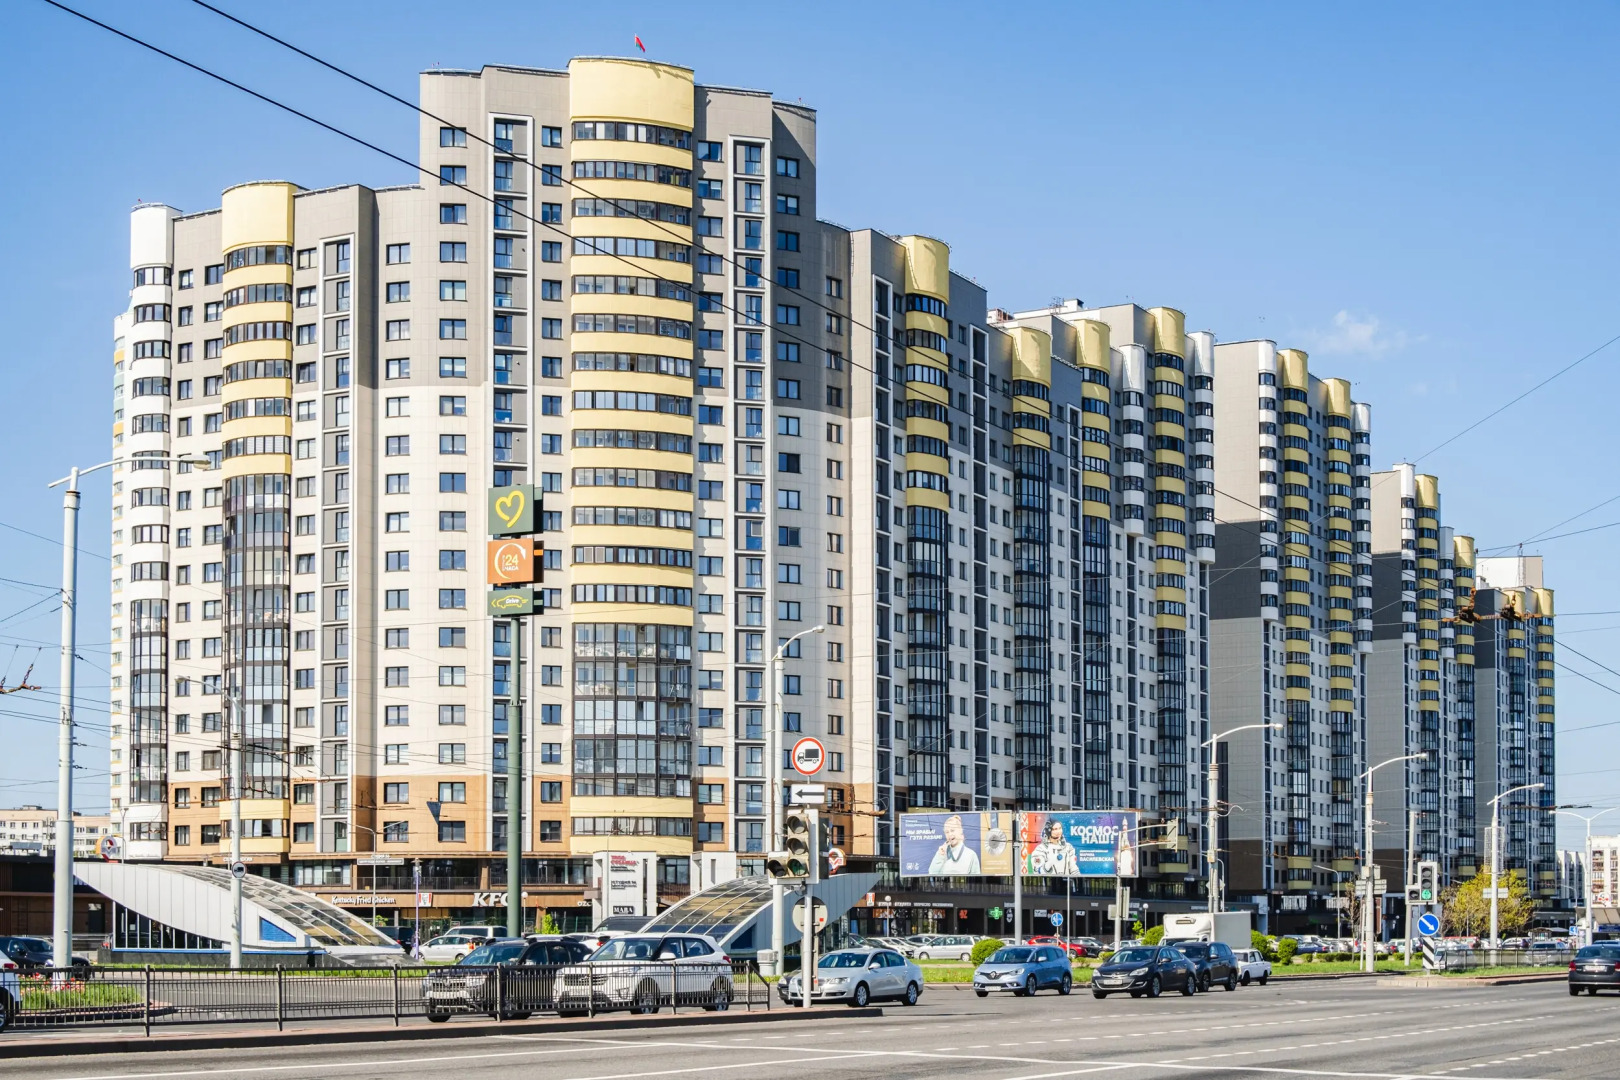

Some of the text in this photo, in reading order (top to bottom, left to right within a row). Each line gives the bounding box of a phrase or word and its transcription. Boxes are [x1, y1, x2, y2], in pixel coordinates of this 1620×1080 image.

[505, 554, 518, 566] 24
[1070, 826, 1119, 836] КОСМОС
[1081, 835, 1115, 844] НАШ!
[332, 896, 396, 905] Kentucky Fried Chicken
